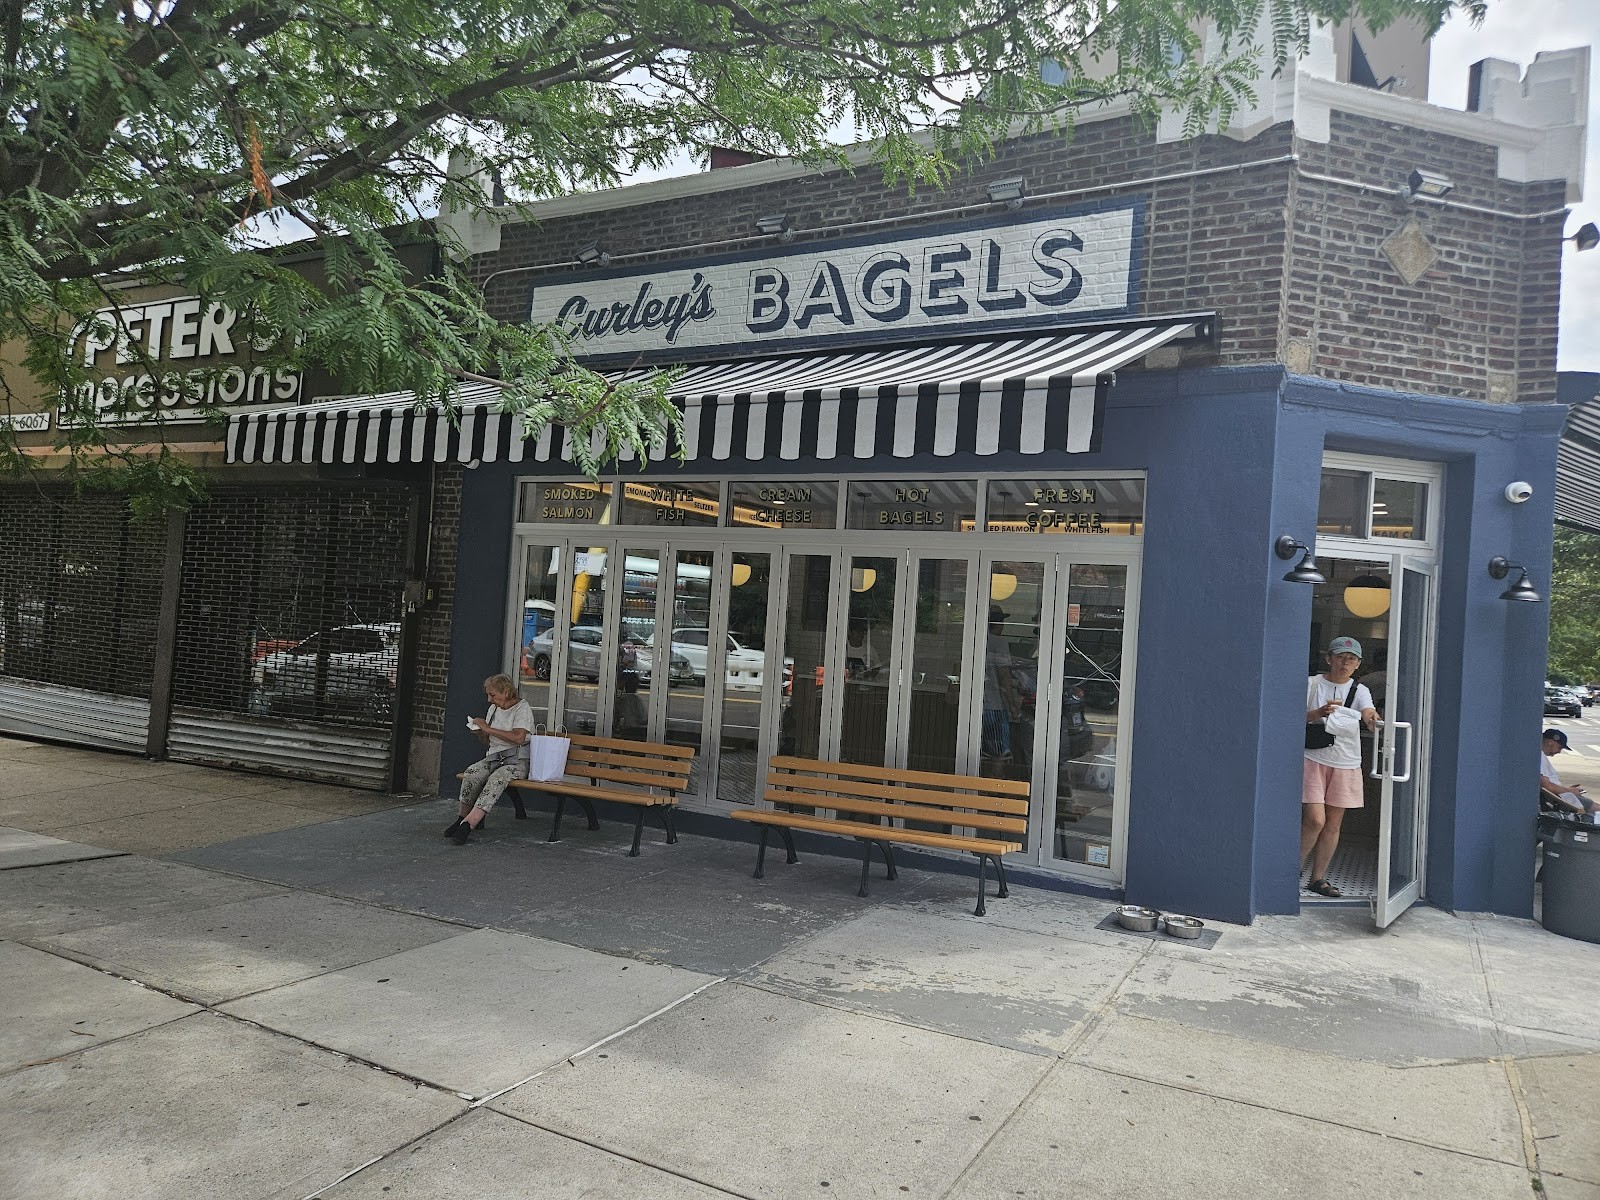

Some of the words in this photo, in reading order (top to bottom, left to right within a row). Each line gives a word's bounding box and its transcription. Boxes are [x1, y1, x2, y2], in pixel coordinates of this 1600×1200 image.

[556, 272, 717, 345] Curley's
[746, 228, 1084, 334] BAGELS
[543, 488, 595, 501] SMOKED
[625, 486, 653, 499] EMONAD
[649, 488, 694, 502] WHITE
[758, 488, 812, 502] CREAM
[895, 488, 930, 502] HOT
[1033, 488, 1096, 503] FRESH
[542, 506, 594, 520] SALMON
[694, 501, 715, 512] SELTZER
[655, 508, 686, 520] FISH
[756, 509, 812, 523] CHEESE
[879, 510, 945, 525] BAGELS
[1025, 512, 1102, 528] COFFEE
[1001, 525, 1036, 533] SALMON
[1064, 526, 1110, 534] WHITEFISH
